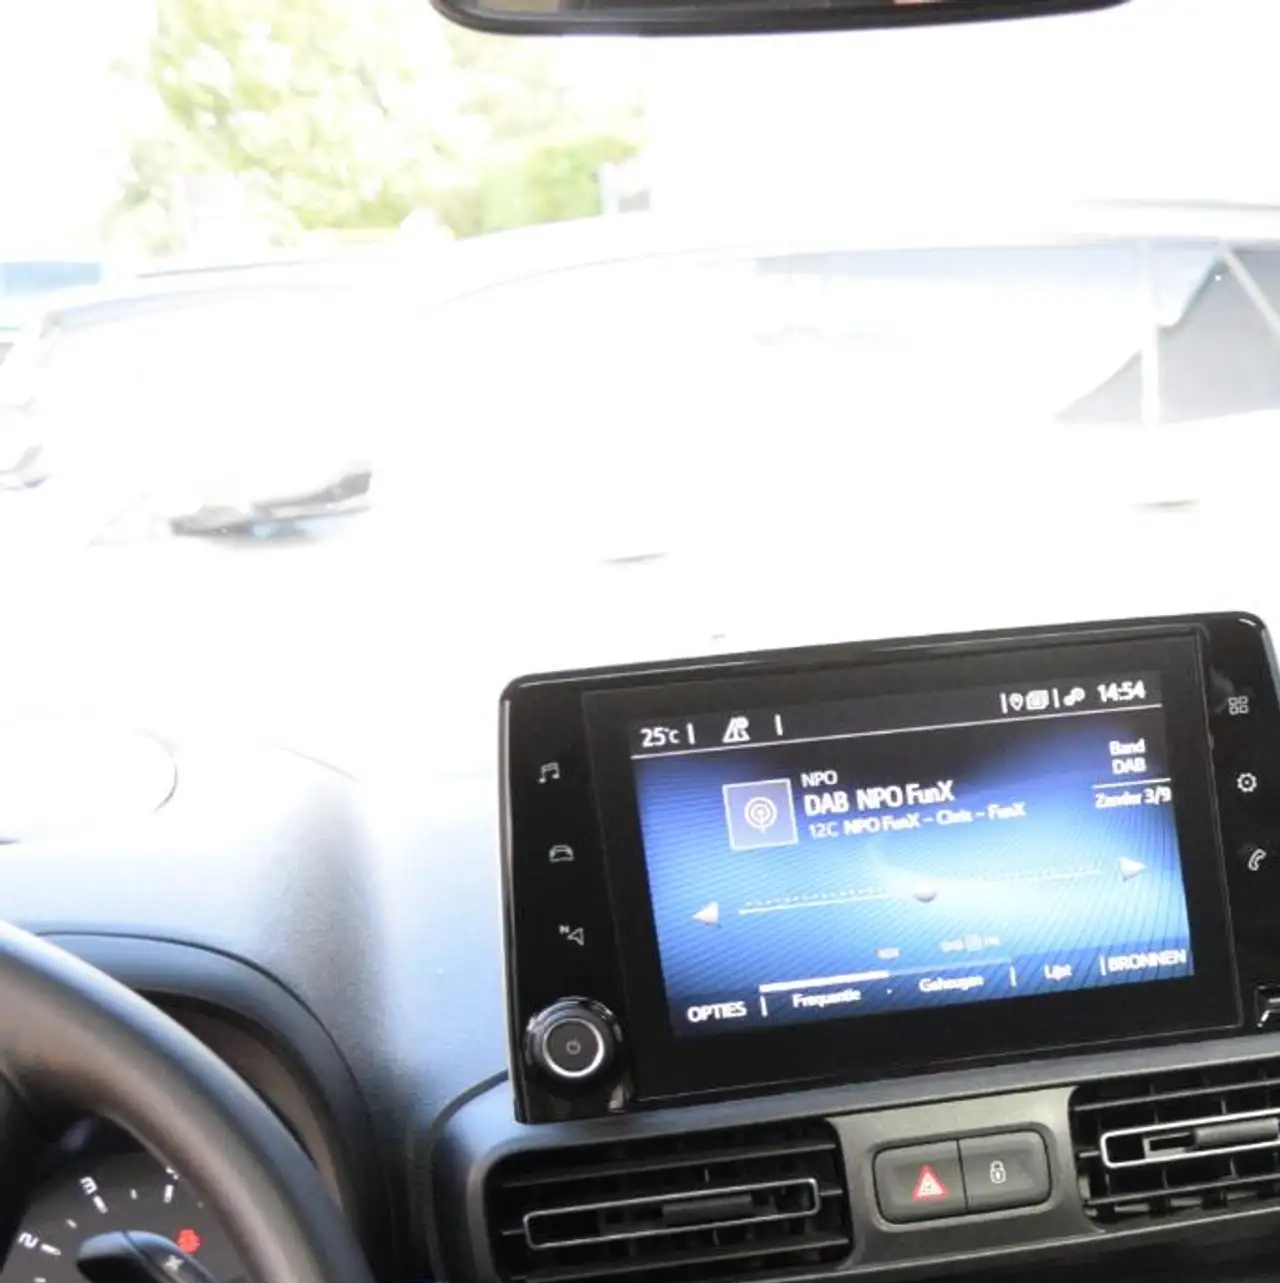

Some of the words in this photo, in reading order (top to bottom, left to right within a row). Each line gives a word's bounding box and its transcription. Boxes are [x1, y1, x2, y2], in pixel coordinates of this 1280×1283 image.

[1097, 680, 1146, 703] 14:54
[1109, 738, 1146, 757] Band
[1112, 756, 1147, 775] DAB
[801, 770, 838, 788] NPO
[804, 790, 849, 817] DAB
[856, 785, 903, 811] NPO
[905, 779, 956, 806] FunX
[1144, 786, 1172, 805] 3/9
[808, 821, 839, 839] 12C
[843, 817, 880, 836] NPO
[1108, 949, 1187, 973] BRONNEN
[687, 1000, 748, 1023] OPTIES
[79, 1175, 98, 1196] 3
[18, 1231, 39, 1250] 2
